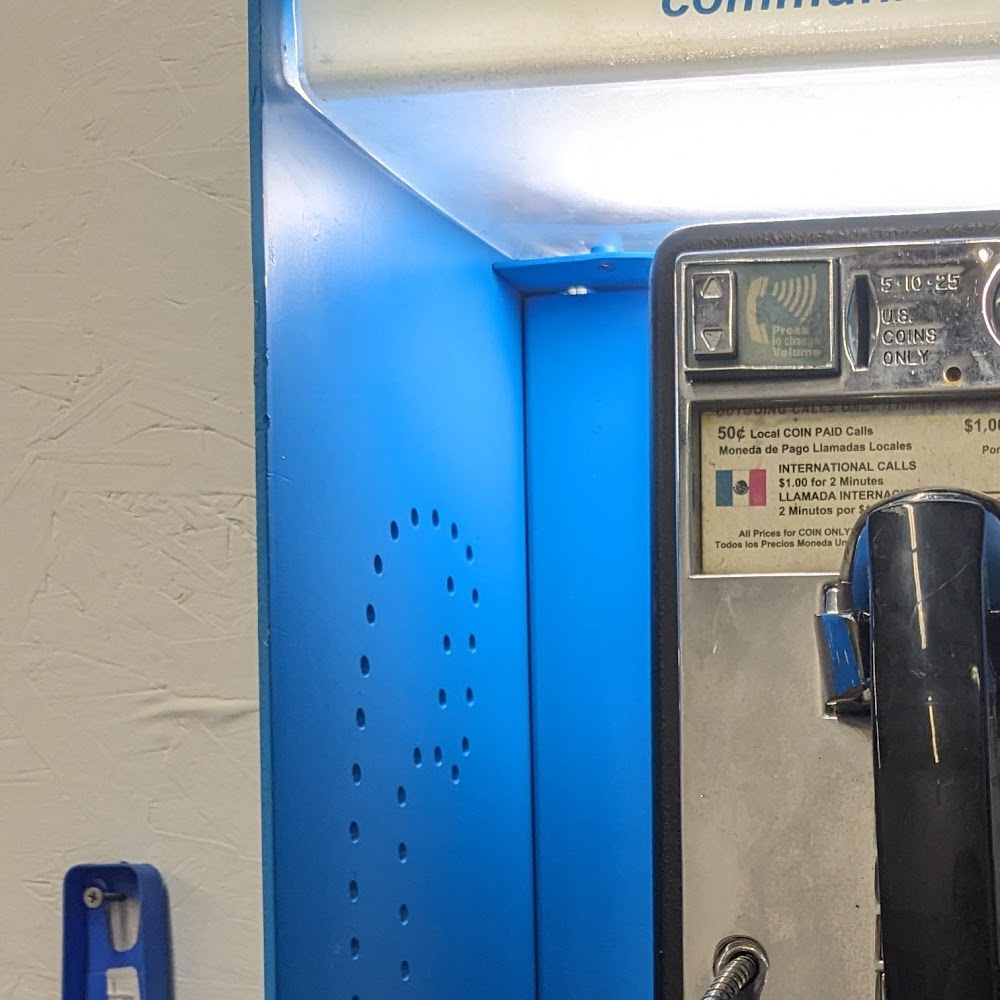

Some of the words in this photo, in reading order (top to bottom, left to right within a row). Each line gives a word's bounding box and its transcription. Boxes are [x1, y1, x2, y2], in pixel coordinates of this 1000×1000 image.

[881, 308, 914, 324] U.S.
[882, 329, 937, 346] COINS
[883, 350, 928, 366] ONLY
[717, 426, 746, 442] 50¢
[750, 428, 780, 439] Local
[783, 427, 812, 437] COIN
[815, 426, 842, 437] PAID
[846, 425, 873, 436] Calls
[719, 445, 762, 455] Moneda
[765, 444, 777, 454] de
[782, 444, 810, 455] Pago
[812, 442, 865, 453] Llamadas
[869, 441, 912, 452] Locales
[982, 445, 1000, 454] Por
[779, 462, 873, 474] INTERNATIONAL
[876, 461, 917, 471] CALLS
[778, 477, 808, 488] $1.00
[811, 477, 827, 487] for
[830, 477, 837, 486] 2
[840, 476, 884, 486] Minutes
[779, 491, 836, 502] LLAMADA
[779, 506, 785, 516] 2
[788, 505, 833, 516] Minutos
[836, 506, 854, 517] por
[738, 530, 751, 538] All
[753, 529, 781, 537] Prices
[784, 528, 796, 537] for
[798, 528, 822, 537] COIN
[715, 541, 742, 549] Todos
[745, 540, 759, 548] los
[761, 540, 794, 548] Precios
[797, 539, 832, 548] Moneda
